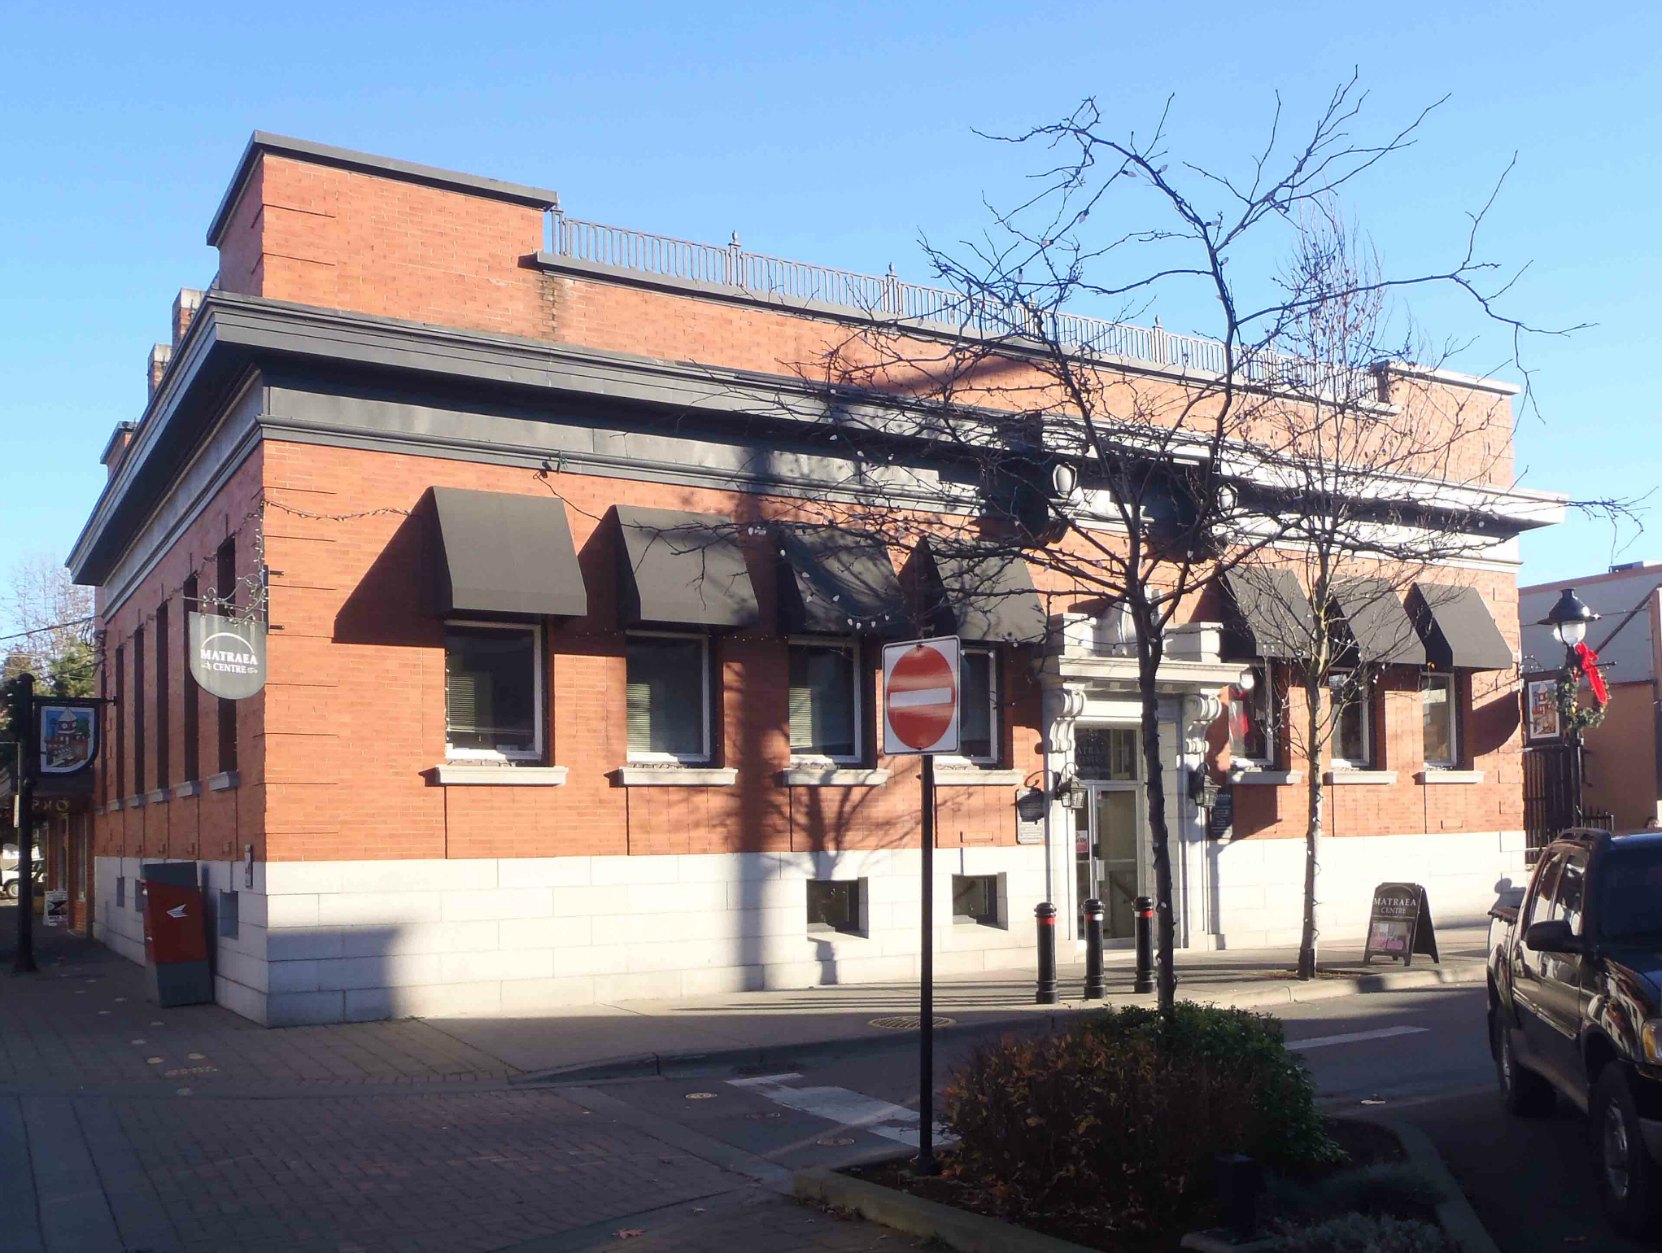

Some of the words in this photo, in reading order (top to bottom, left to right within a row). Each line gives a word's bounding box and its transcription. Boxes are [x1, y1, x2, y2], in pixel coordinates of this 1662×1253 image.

[200, 648, 258, 665] MATRAEA
[212, 662, 247, 674] CENTRE
[1373, 897, 1417, 906] MATRAEA
